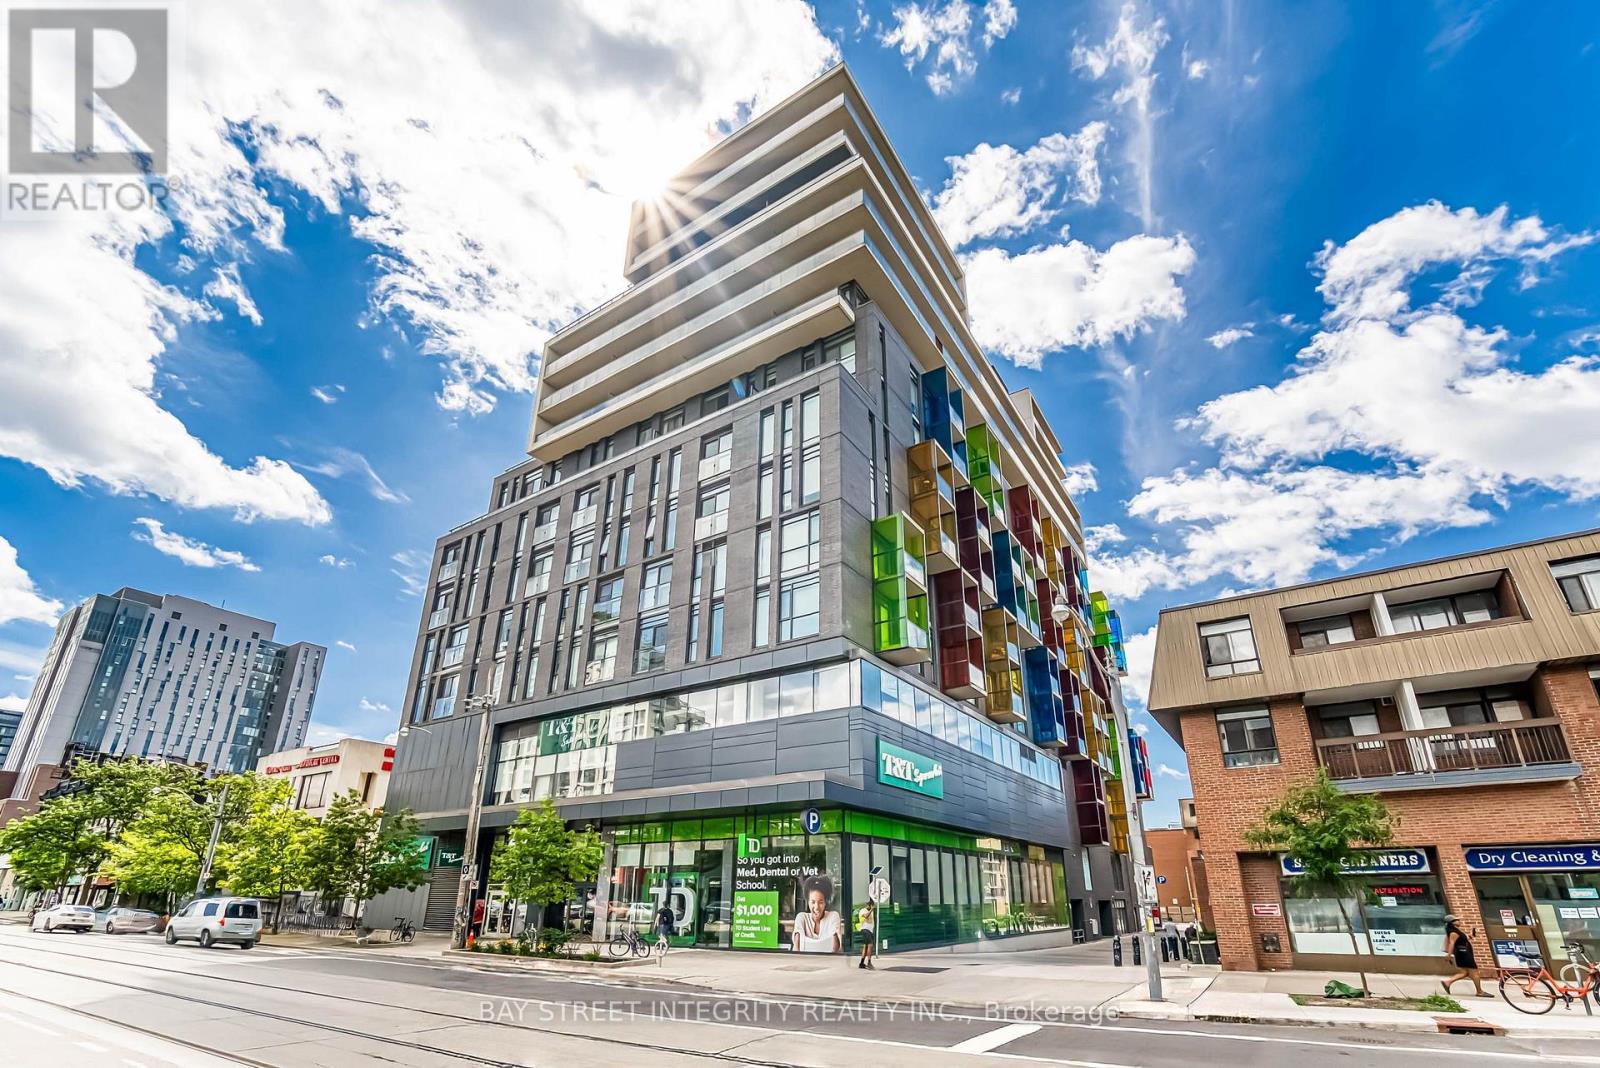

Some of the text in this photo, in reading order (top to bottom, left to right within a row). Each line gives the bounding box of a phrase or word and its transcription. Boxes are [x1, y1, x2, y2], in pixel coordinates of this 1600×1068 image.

[882, 752, 914, 781] T&T
[809, 812, 819, 830] P
[746, 838, 761, 853] TD
[737, 854, 800, 865] So you got into
[1478, 849, 1600, 865] Dry Cleaning &
[736, 866, 819, 878] Med, Dental or Vet
[736, 880, 767, 890] School.
[1374, 887, 1424, 895] ALTERATION
[649, 886, 697, 928] TD
[736, 904, 773, 917] $1,000
